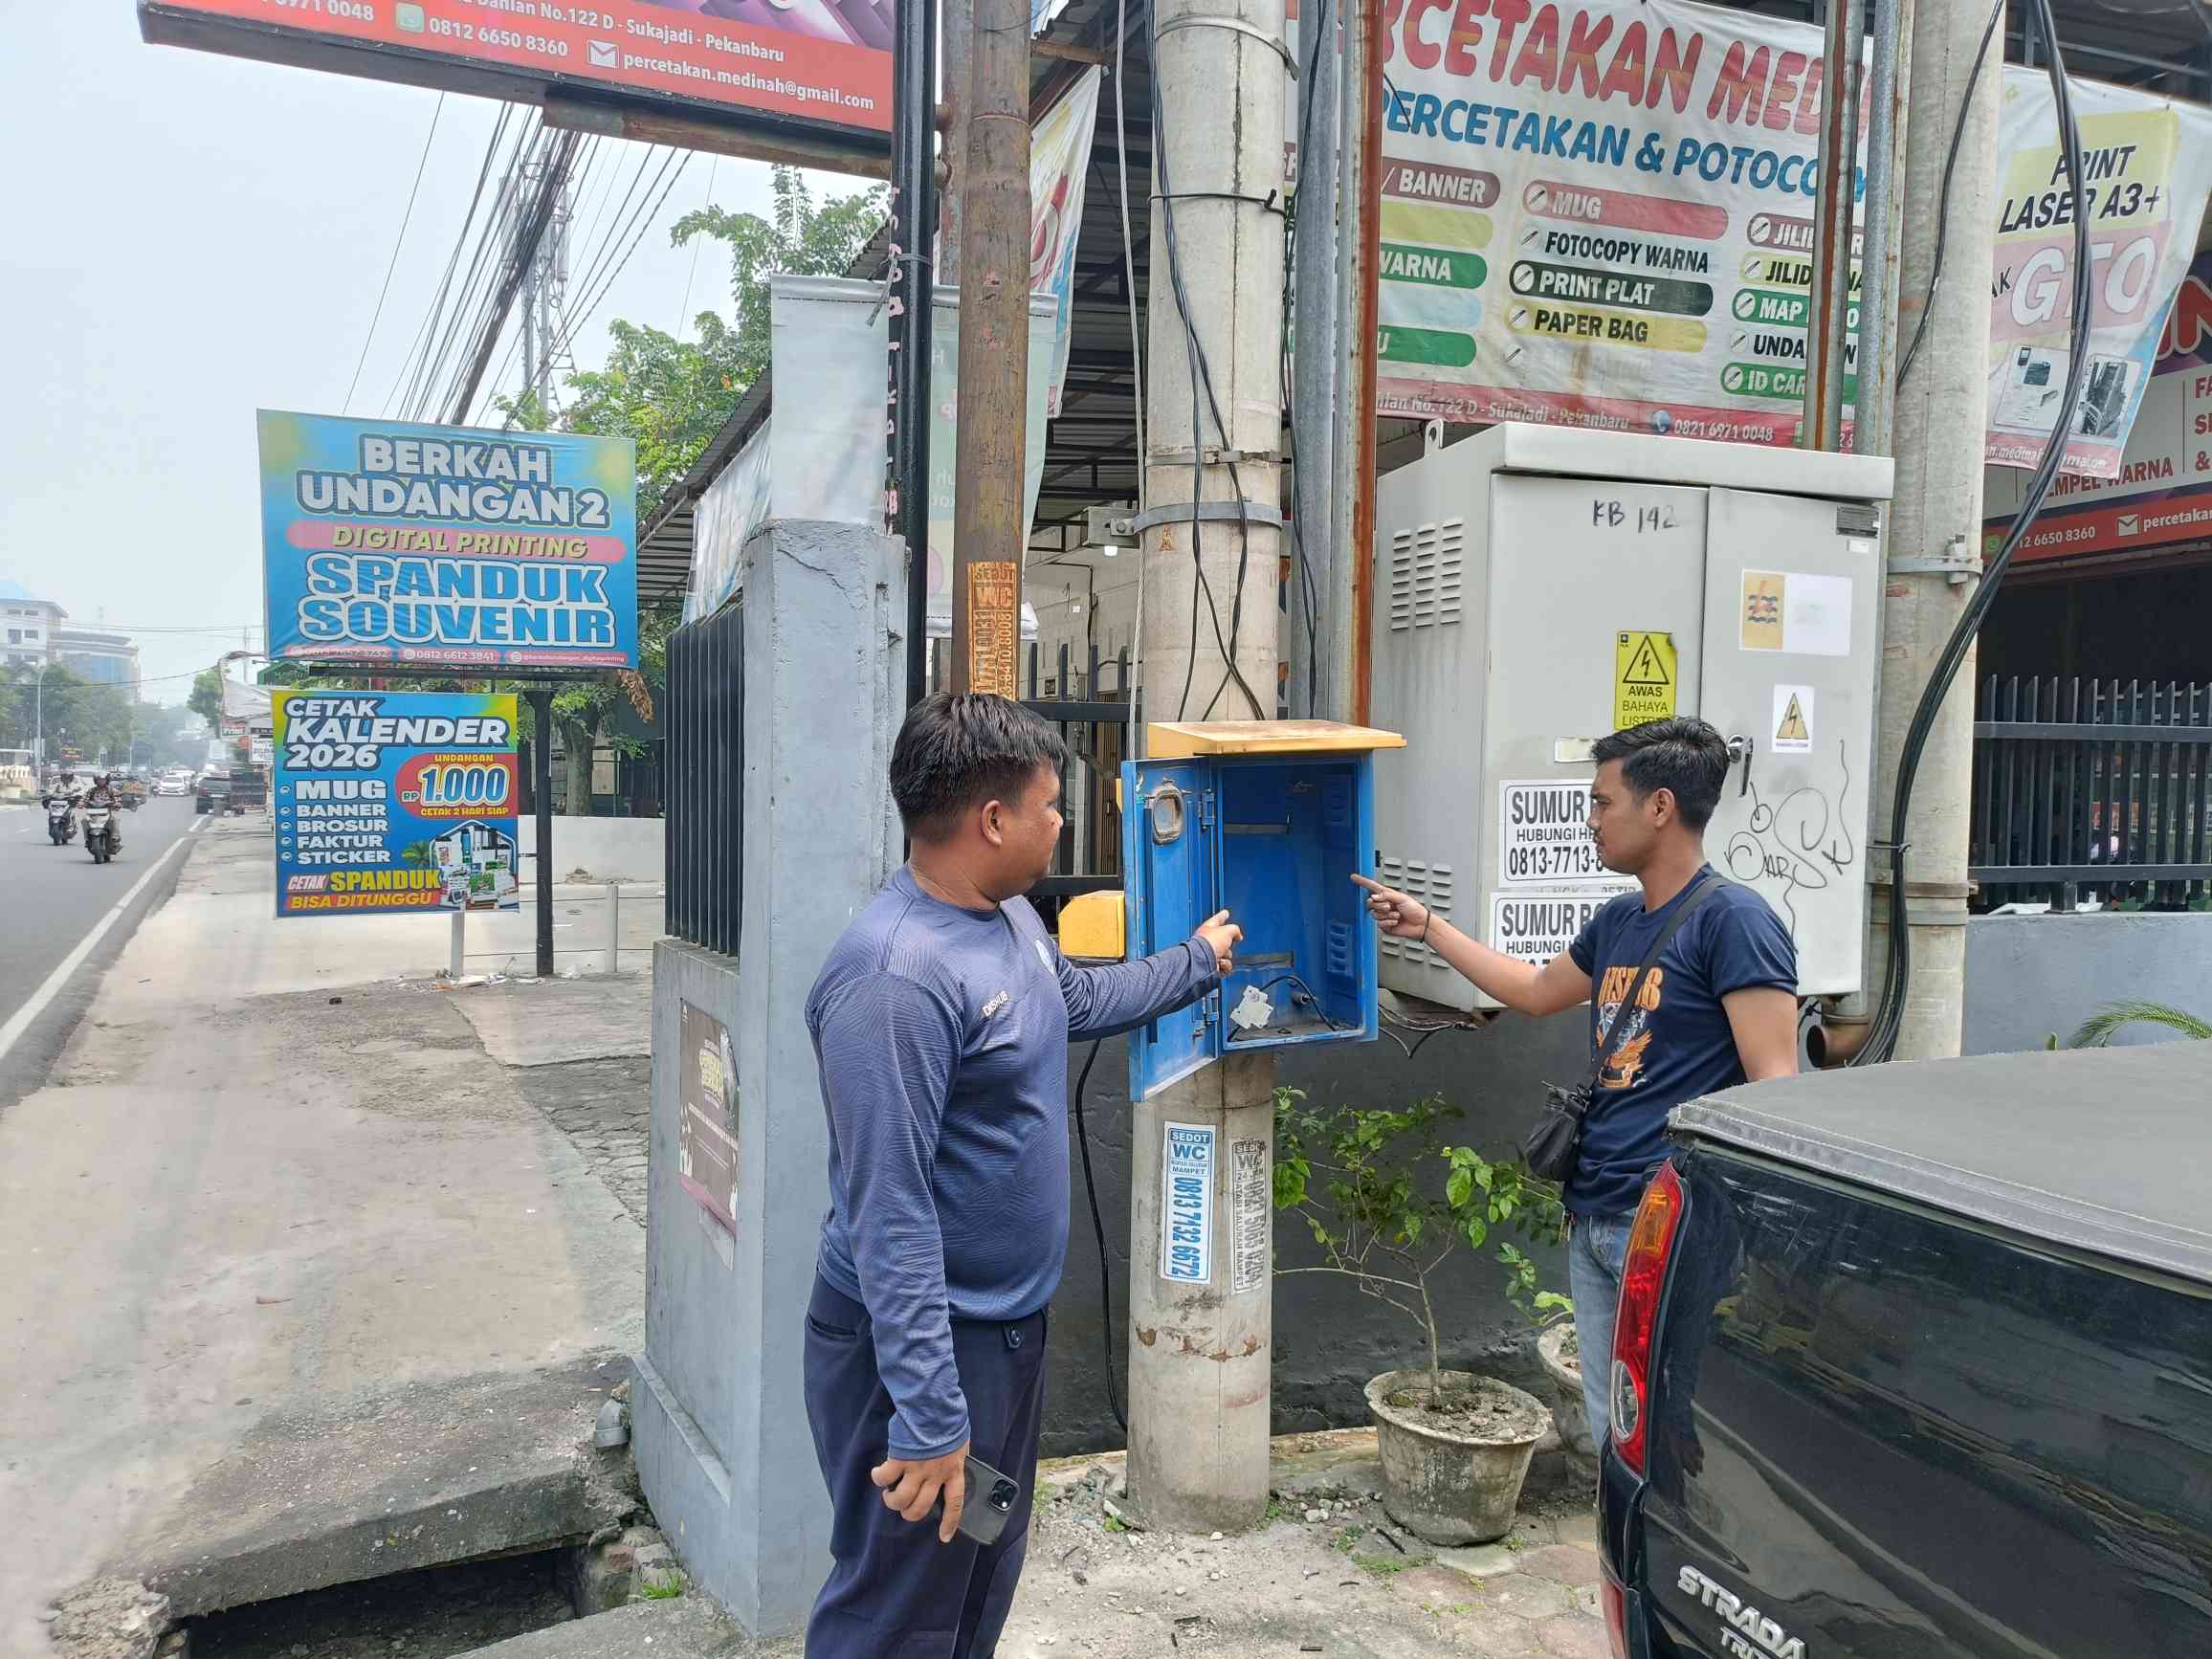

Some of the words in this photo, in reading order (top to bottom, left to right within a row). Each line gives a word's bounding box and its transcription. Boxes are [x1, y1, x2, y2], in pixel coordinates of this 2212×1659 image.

[430, 17, 475, 40] 0812
[477, 26, 521, 48] 6650
[525, 35, 568, 56] 8360
[603, 16, 614, 30] D
[627, 19, 694, 44] Sukajadi
[705, 33, 785, 62] Pekanbaru
[624, 52, 874, 110] percetakan.medinah@gmail.com
[1382, 90, 1630, 166] ERCETAKAN
[1635, 132, 1665, 173] &
[1399, 167, 1486, 203] BANNER
[1552, 190, 1602, 219] MUG
[2098, 183, 2160, 219] A3+
[1545, 231, 1643, 265] FOTOCOPY
[1646, 244, 1709, 274] WARNA
[1538, 270, 1603, 299] PRINT
[1605, 278, 1655, 305] PLAT
[1759, 298, 1803, 322] MAP
[1534, 309, 1603, 337] PAPER
[1607, 318, 1648, 343] BAG
[1747, 369, 1768, 391] ID
[1673, 419, 1705, 436] 0821
[1742, 425, 1773, 442] 0048
[363, 436, 550, 484] BERKAH
[299, 473, 573, 524] UNDANGAN
[579, 491, 608, 526] 2
[1592, 499, 1626, 527] KB
[332, 526, 450, 552] DIGITAL
[457, 536, 588, 559] PRINTING
[2033, 530, 2063, 547] 6650
[2065, 525, 2095, 542] 8360
[308, 553, 609, 607] SPANDUK
[299, 595, 615, 647] SOUVENIR
[1628, 685, 1663, 697] AWAS
[286, 698, 379, 718] CETAK
[1622, 699, 1669, 713] BAHAYA
[287, 718, 507, 744] KALENDER
[286, 743, 379, 768] 2026
[435, 754, 494, 763] UNDANGAN
[296, 781, 387, 801] MUG
[418, 763, 510, 807] 1.000
[298, 804, 387, 817] BANNER
[1512, 790, 1585, 825] SUMUR
[298, 819, 388, 833] BROSUR
[1516, 828, 1576, 842] HUBUNGI
[298, 834, 383, 850] FAKTUR
[298, 851, 391, 865] STICKER
[288, 874, 327, 891] CETAK
[330, 869, 441, 892] SPANDUK
[336, 892, 432, 907] DITUNGGU
[1501, 902, 1575, 937] SUMUR
[1171, 1132, 1209, 1143] SEDOT
[1173, 1143, 1206, 1160] WC
[1174, 1178, 1203, 1208] 0813
[1677, 1564, 1806, 1659] STRADA
